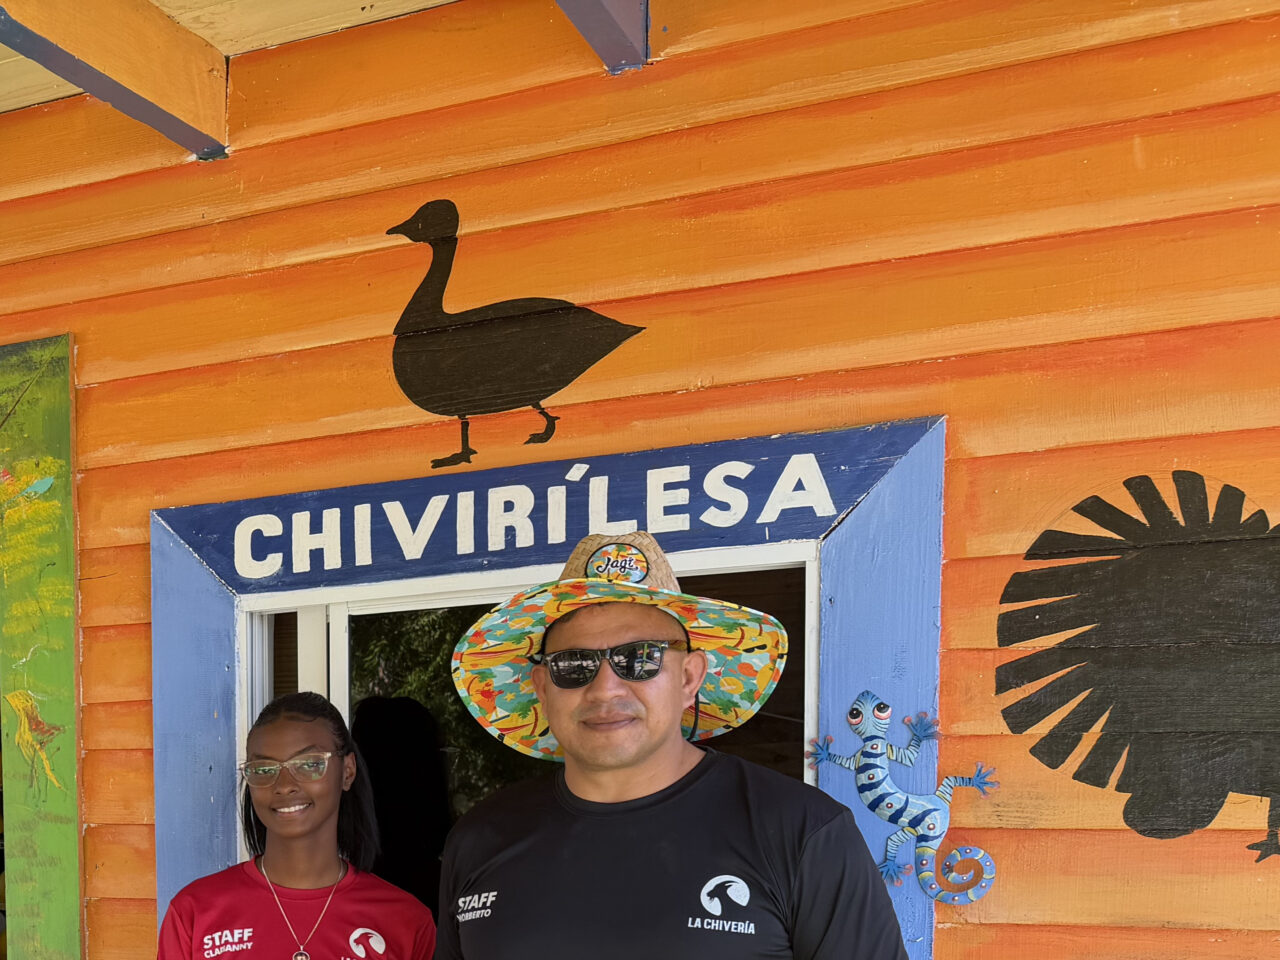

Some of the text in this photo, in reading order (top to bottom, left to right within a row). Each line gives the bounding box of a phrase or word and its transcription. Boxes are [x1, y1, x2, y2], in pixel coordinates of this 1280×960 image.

[234, 453, 837, 579] CHIVIRÍLESA
[458, 891, 498, 913] STAFF
[688, 917, 756, 935] LA CHIVERÍA
[203, 927, 254, 949] STAFF
